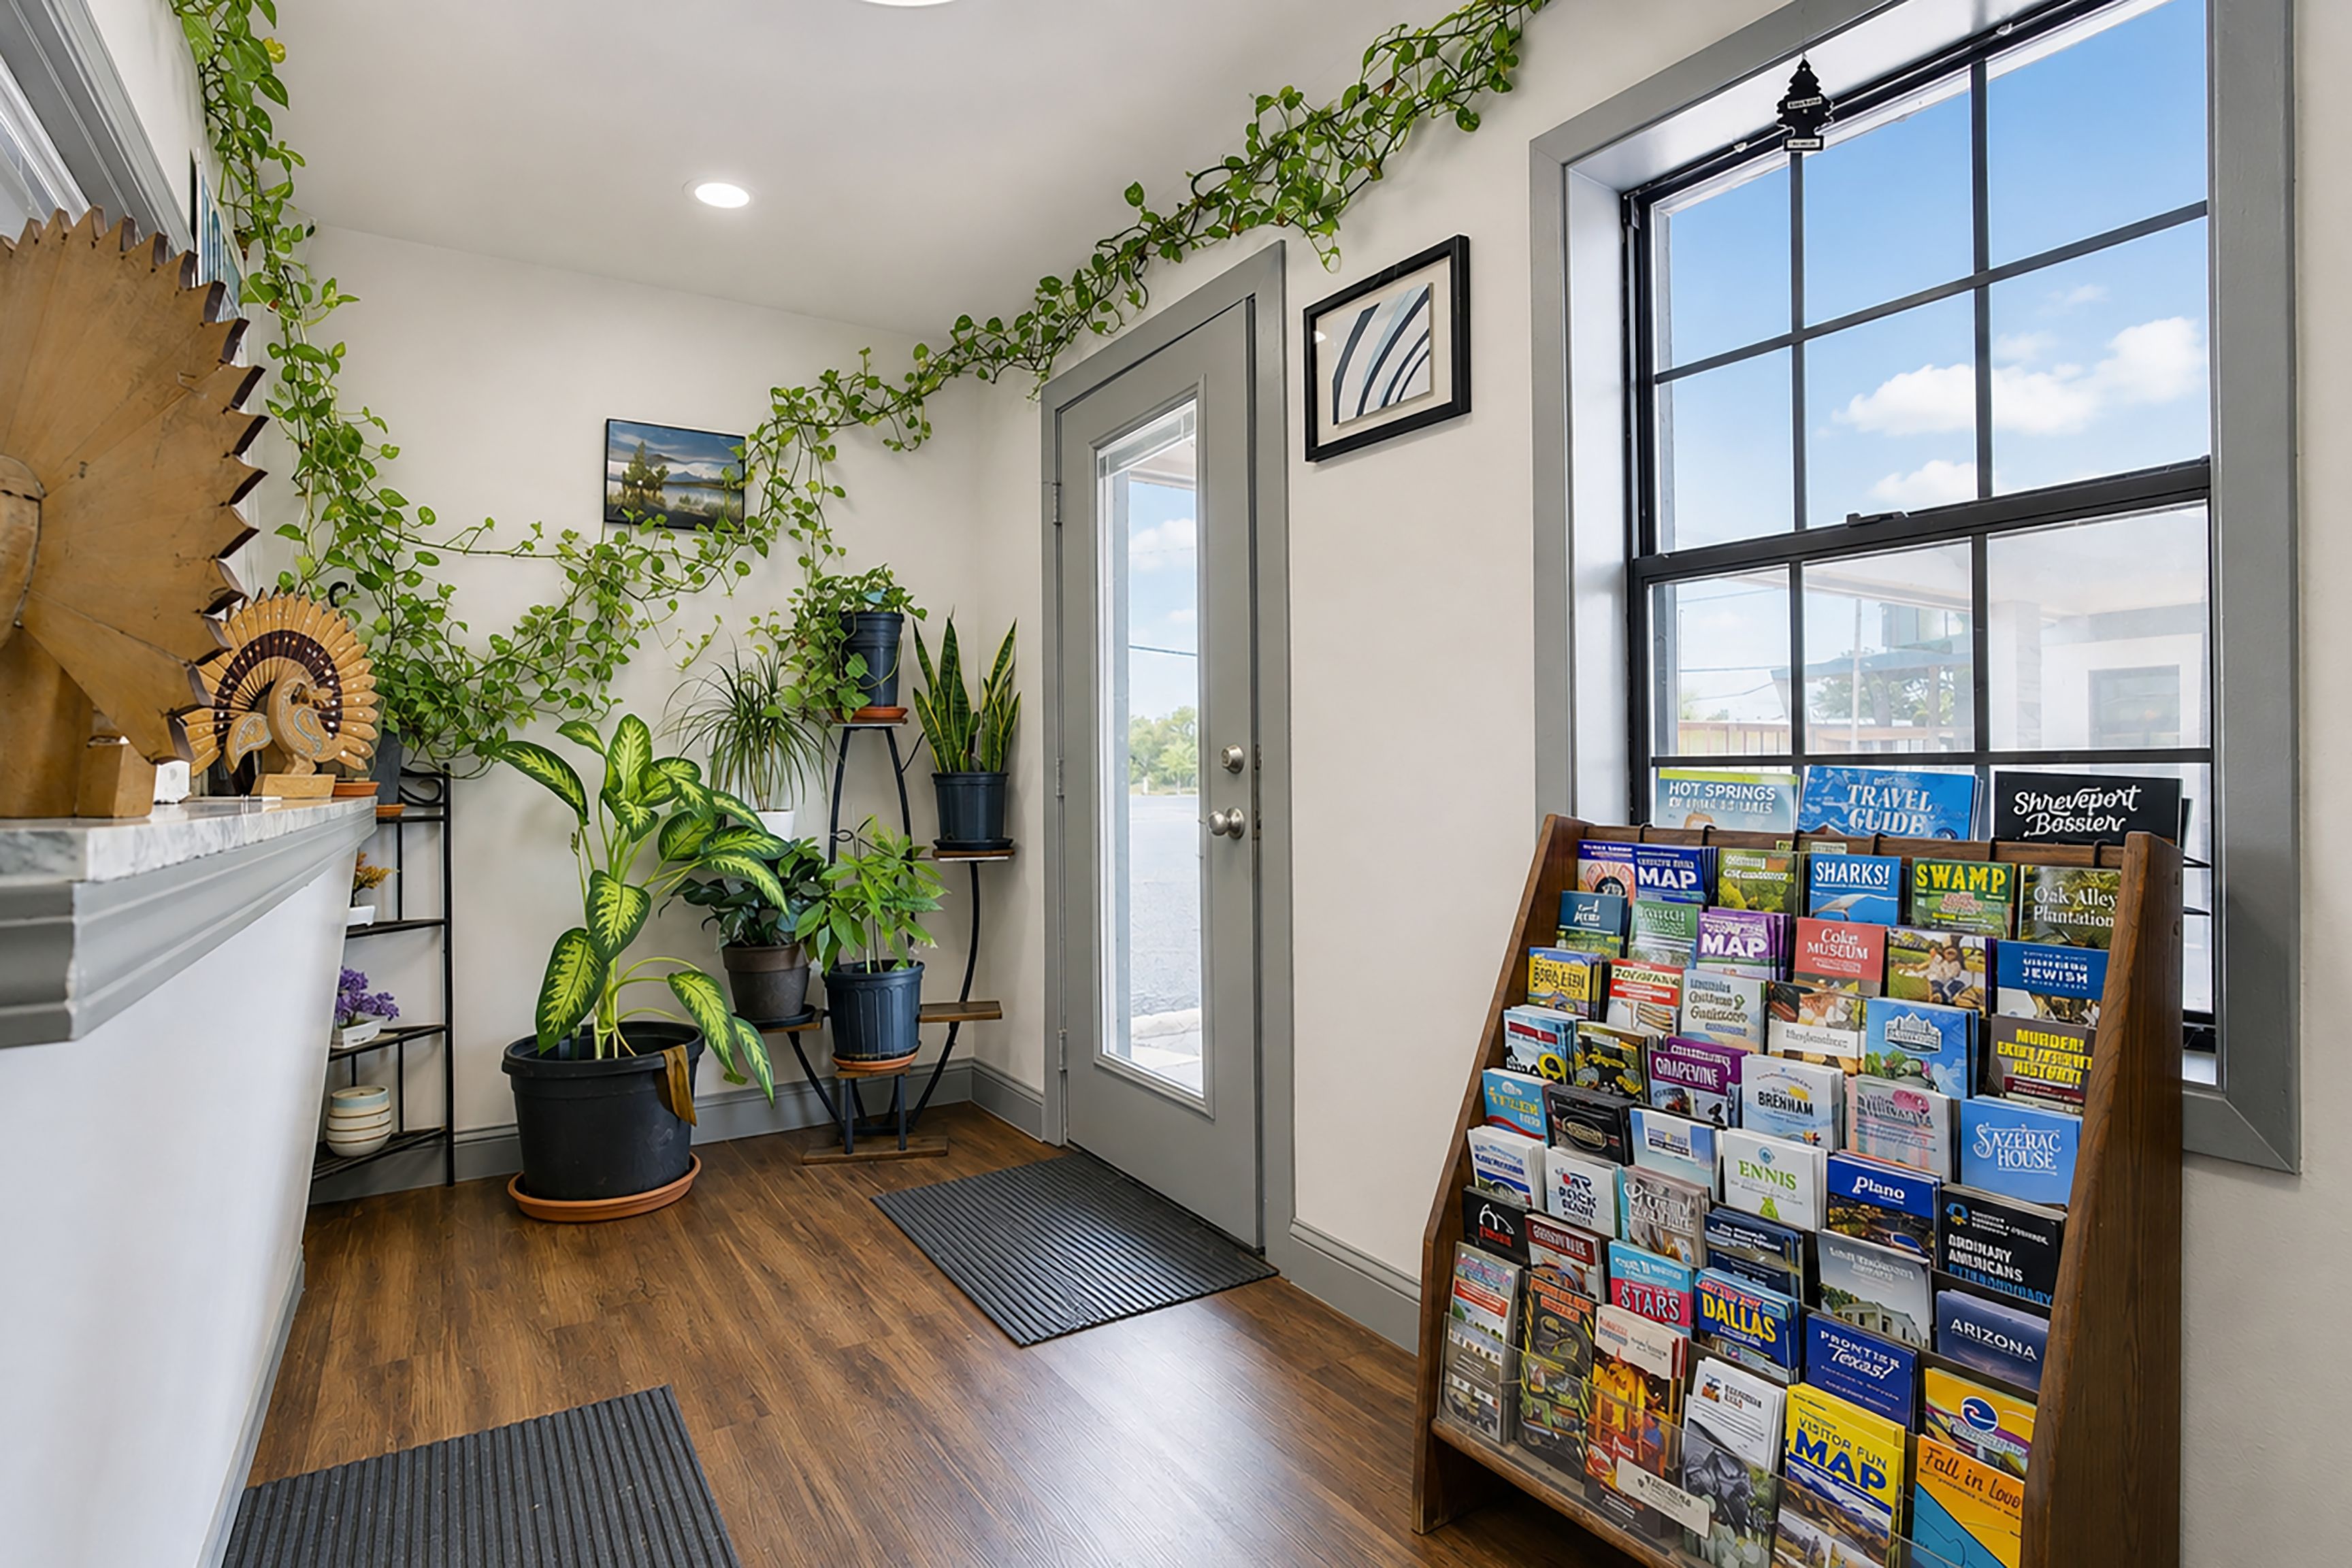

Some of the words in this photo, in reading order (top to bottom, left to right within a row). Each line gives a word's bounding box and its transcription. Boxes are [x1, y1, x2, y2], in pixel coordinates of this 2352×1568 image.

[1669, 781, 1701, 798] HOT
[1704, 783, 1776, 801] SPRINGS
[1847, 784, 1934, 813] TRAVEL
[2013, 784, 2142, 815] Shreveport
[2023, 813, 2126, 837] Bossier
[1638, 866, 1697, 889] MAP
[1815, 862, 1891, 885] SHARKS!
[1916, 864, 2006, 893] SWAMP
[2034, 885, 2070, 904] Oak
[2078, 887, 2118, 912] Alley
[2034, 905, 2114, 927] Plantation
[1701, 933, 1767, 958] MAP
[1820, 928, 1859, 945] Coke
[1738, 1159, 1797, 1190] ENNIS
[1997, 1150, 2057, 1170] HOUSE
[1620, 1284, 1680, 1322] STARS
[1701, 1291, 1776, 1343] DALLAS
[1950, 1318, 2038, 1361] ARIZONA
[1795, 1426, 1886, 1490] MAP
[1799, 1417, 1852, 1450] VISITOR
[1857, 1446, 1887, 1470] FUN
[1923, 1446, 1960, 1481] Fall
[1964, 1469, 1983, 1493] in
